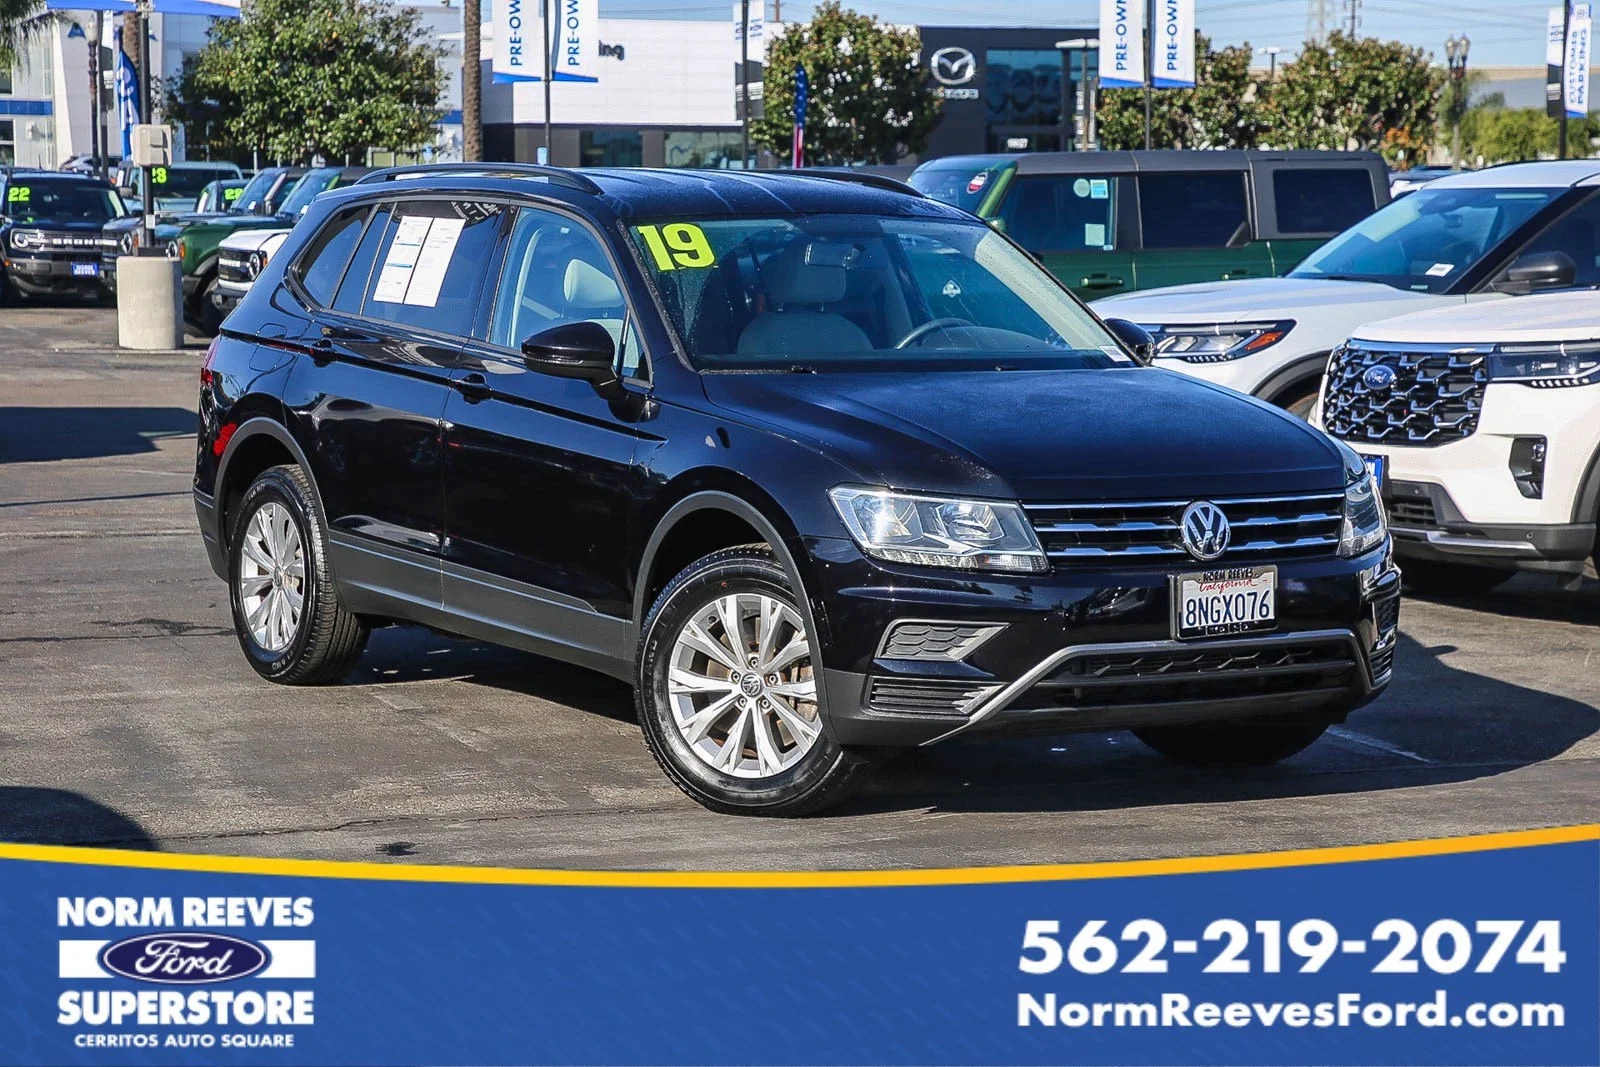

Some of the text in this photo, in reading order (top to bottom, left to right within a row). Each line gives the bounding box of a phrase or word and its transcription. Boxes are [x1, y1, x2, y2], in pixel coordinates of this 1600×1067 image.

[1577, 28, 1588, 104] PARKING
[8, 187, 31, 202] 22
[637, 222, 716, 271] 19
[1199, 579, 1257, 594] California
[1203, 568, 1254, 582] NORM REEVES
[1186, 590, 1270, 626] 8NGX076
